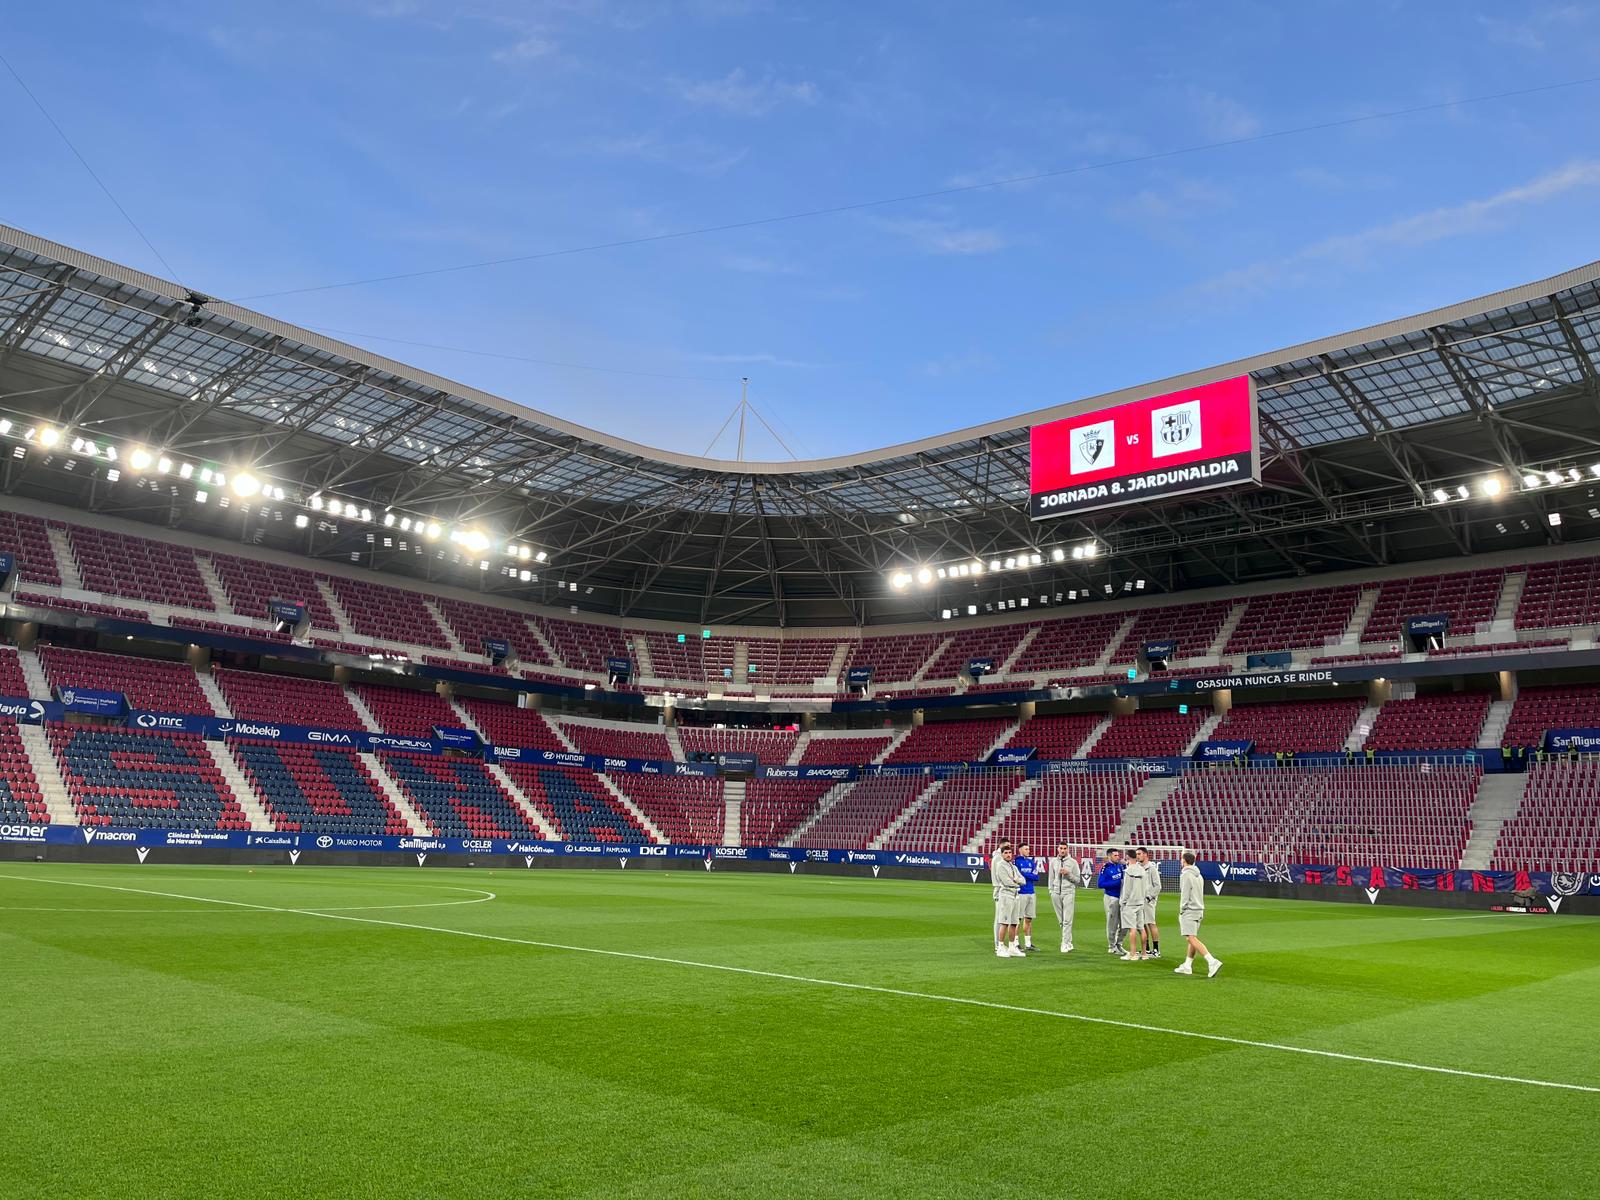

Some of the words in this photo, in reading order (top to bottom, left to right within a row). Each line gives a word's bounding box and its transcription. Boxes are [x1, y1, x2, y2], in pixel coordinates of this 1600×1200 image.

[1126, 433, 1139, 445] VS
[1040, 484, 1109, 509] JORNADA
[1111, 482, 1125, 495] 8.
[1127, 459, 1240, 492] JARDUNALDIA
[1196, 677, 1243, 688] OSASUNA
[1245, 675, 1281, 685] NUNCA
[1283, 673, 1296, 683] SE
[1299, 671, 1332, 681] RINDE
[159, 717, 183, 727] mrc
[235, 723, 280, 738] Mobekip
[307, 731, 351, 744] GIMA
[1129, 763, 1166, 772] Noticias
[0, 825, 48, 837] osner
[96, 831, 136, 841] macron
[470, 841, 492, 849] CELER
[519, 844, 543, 853] Halcón
[640, 847, 667, 855] DIGI
[906, 856, 929, 864] Halcón
